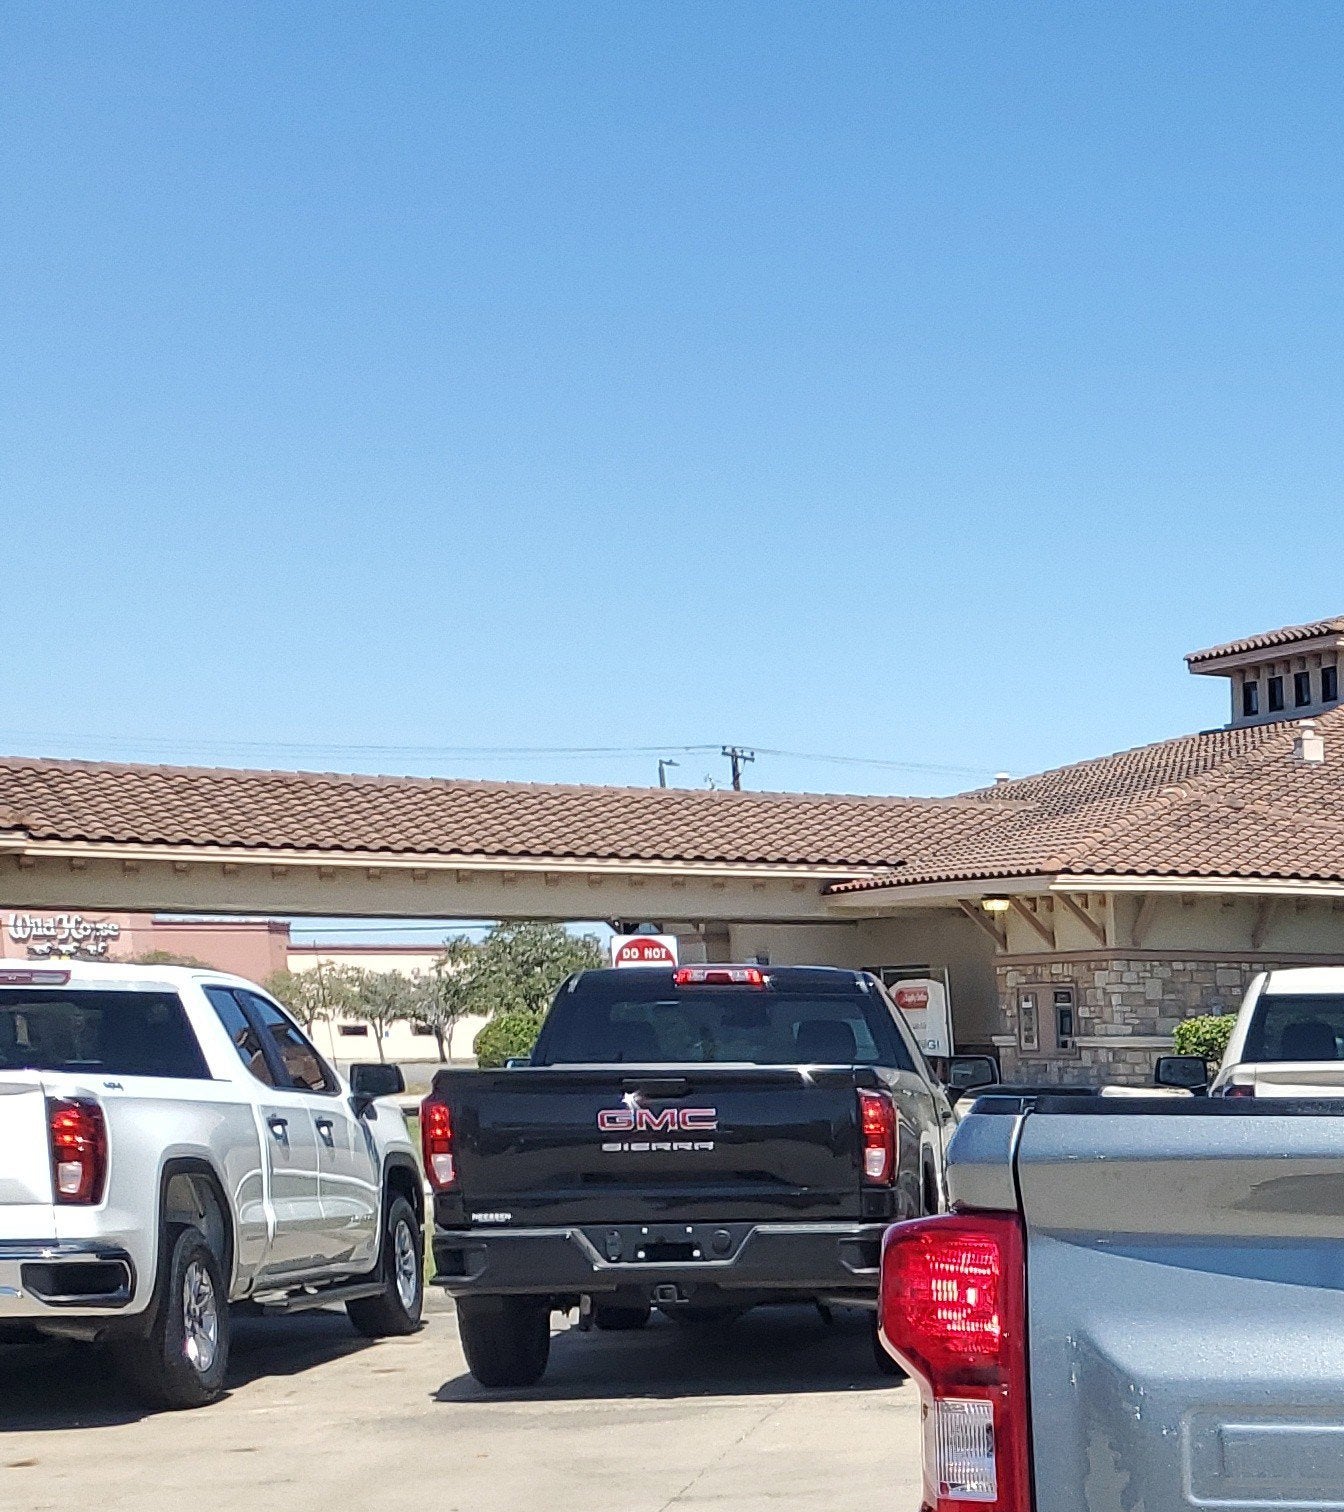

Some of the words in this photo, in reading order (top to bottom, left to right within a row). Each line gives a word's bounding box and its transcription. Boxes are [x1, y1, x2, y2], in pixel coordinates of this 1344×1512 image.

[622, 947, 640, 959] DO
[644, 947, 667, 959] NOT
[597, 1107, 718, 1133] GMC
[601, 1141, 715, 1152] SIERRA
